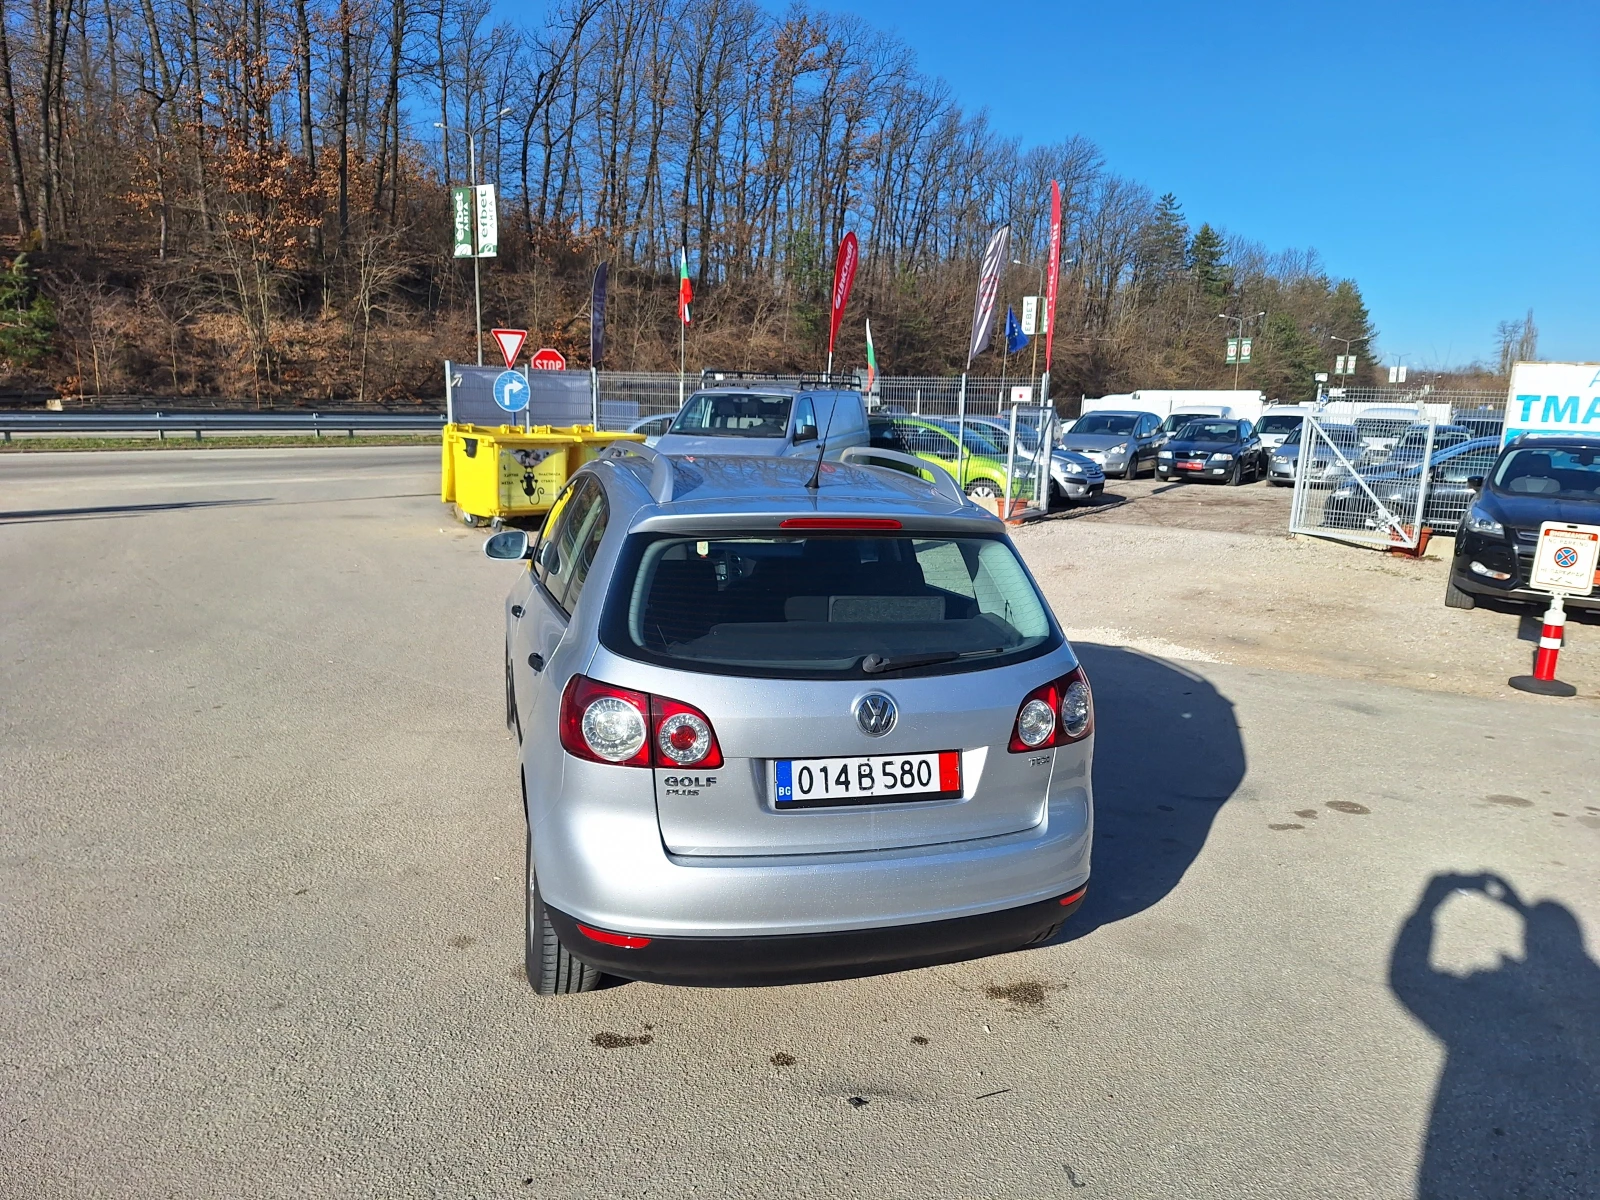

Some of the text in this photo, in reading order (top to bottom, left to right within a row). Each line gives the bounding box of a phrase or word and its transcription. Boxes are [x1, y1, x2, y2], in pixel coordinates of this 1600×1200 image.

[455, 191, 464, 241] efbet
[480, 190, 488, 237] efbet
[838, 241, 854, 295] UniCredit
[1024, 300, 1033, 332] EFBET
[535, 359, 563, 370] STOP
[664, 776, 717, 787] GOLF
[778, 786, 791, 796] BG
